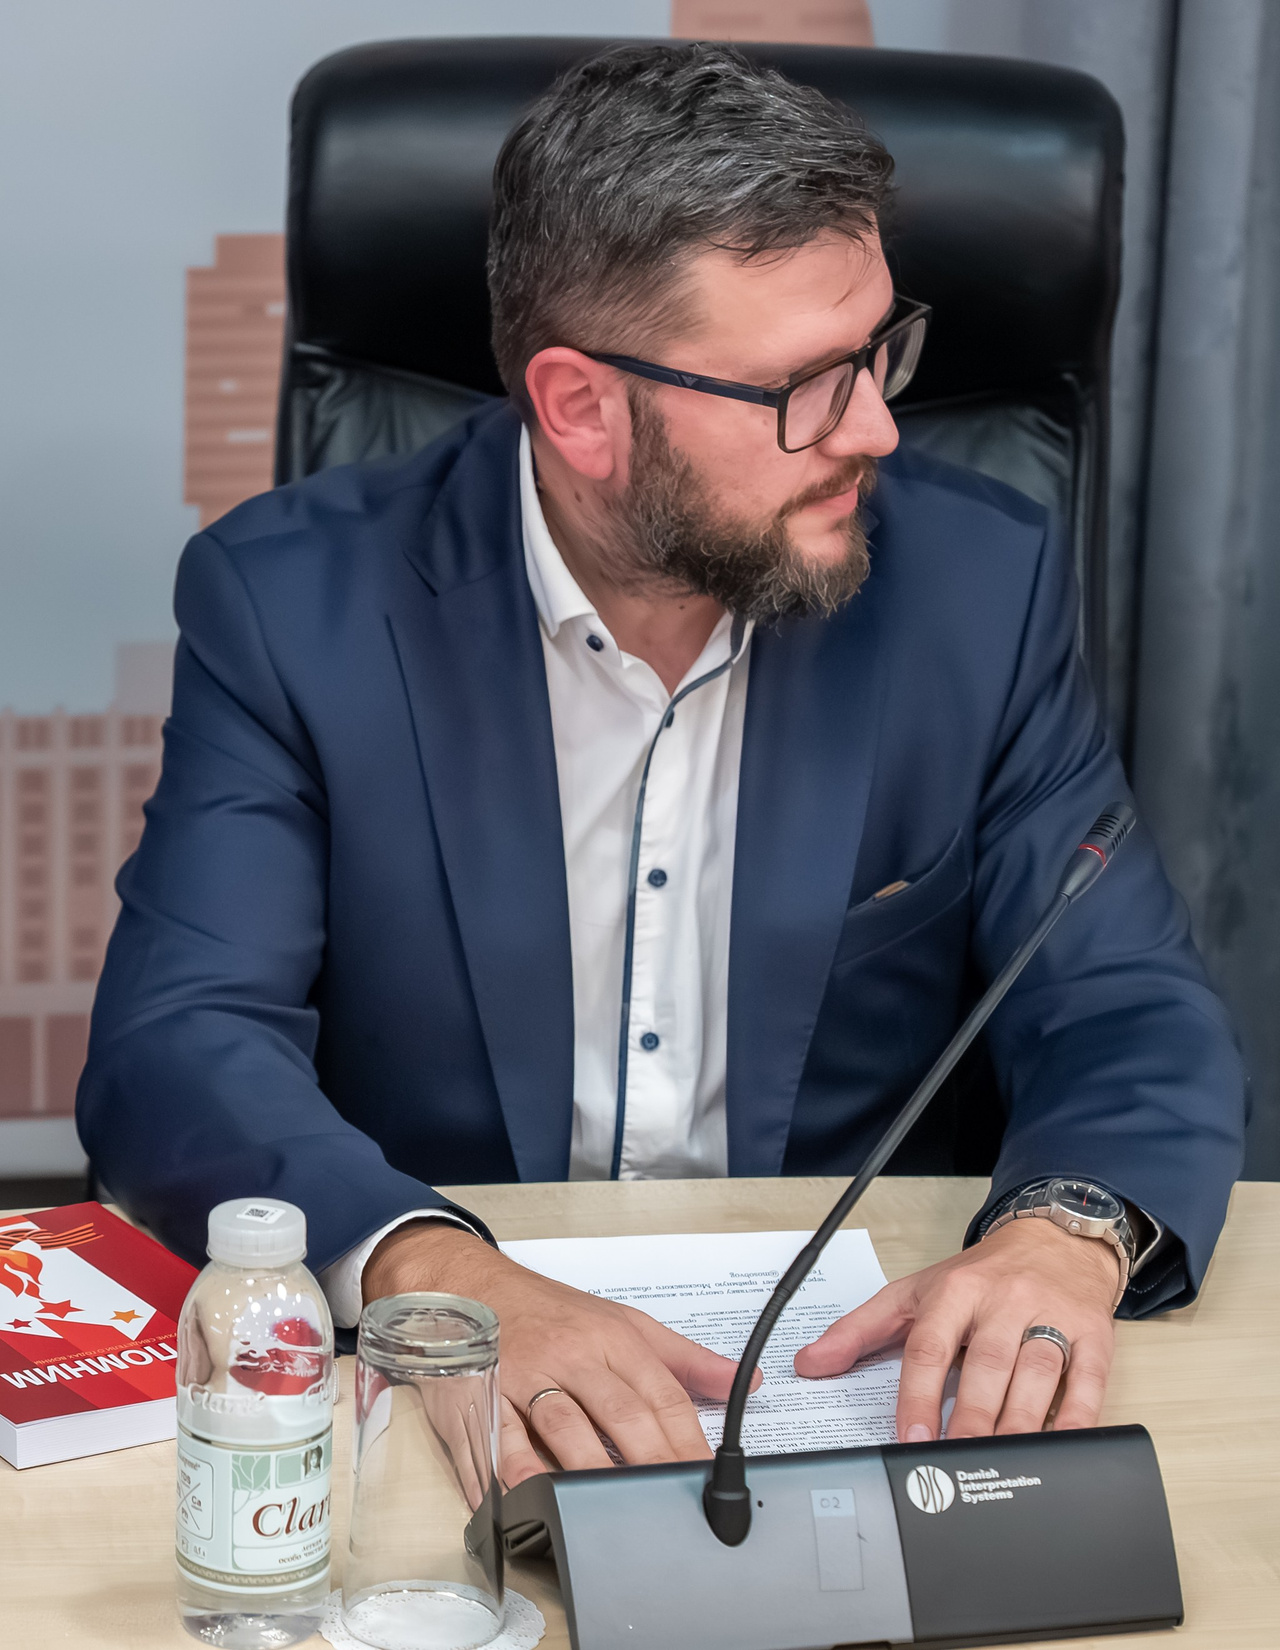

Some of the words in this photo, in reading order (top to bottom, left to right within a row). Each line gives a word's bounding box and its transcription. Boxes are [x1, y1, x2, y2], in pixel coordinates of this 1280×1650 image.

[730, 1270, 779, 1278] @mosobvog
[656, 1283, 711, 1291] Московского
[106, 1337, 155, 1352] СВИДЕТЕЛИ
[34, 1355, 67, 1364] ВОЙНЫ
[69, 1350, 96, 1359] ГОДАХ
[0, 1342, 177, 1389] ПОМНИМ
[955, 1468, 1000, 1482] Danish
[958, 1475, 1042, 1493] Interpretation
[961, 1489, 1014, 1505] Systems
